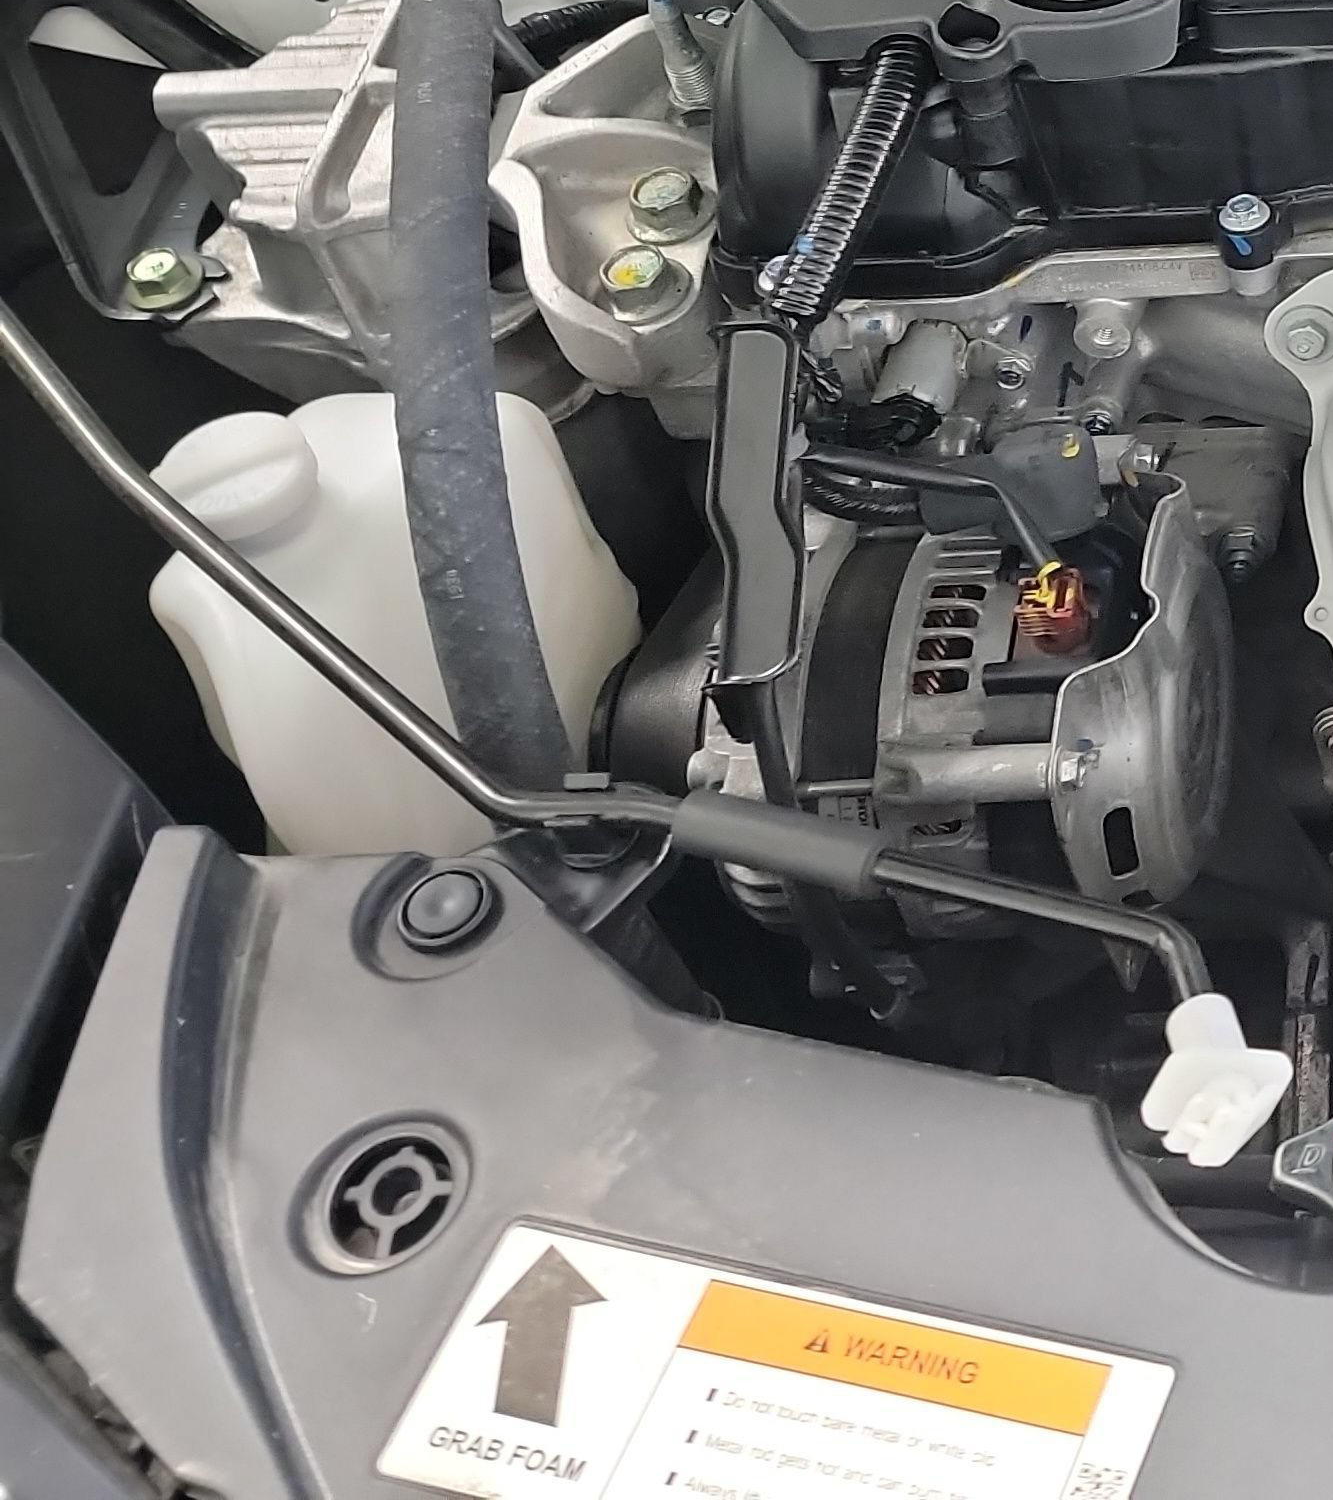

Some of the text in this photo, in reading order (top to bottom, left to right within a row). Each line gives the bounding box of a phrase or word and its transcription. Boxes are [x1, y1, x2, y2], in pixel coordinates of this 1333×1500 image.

[842, 1332, 981, 1386] WARNING
[427, 1425, 588, 1483] GRAB FOAM
